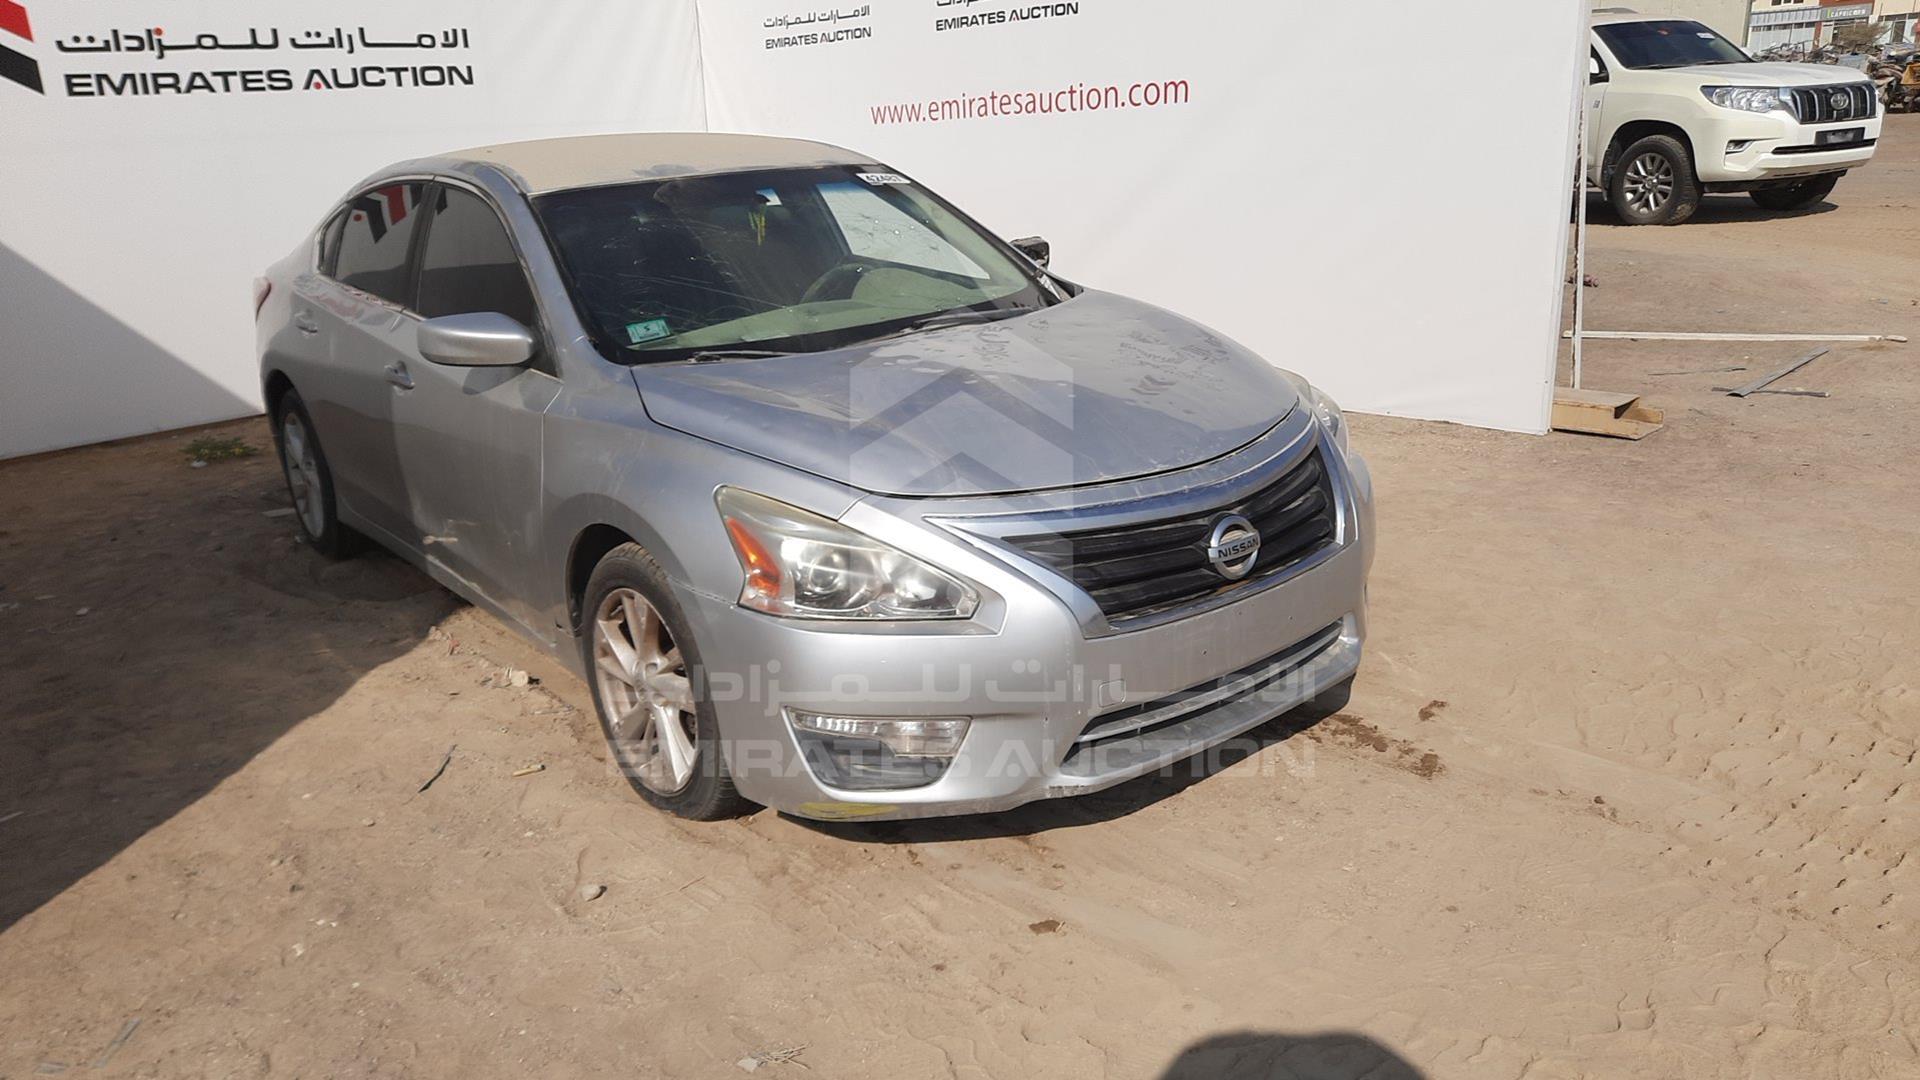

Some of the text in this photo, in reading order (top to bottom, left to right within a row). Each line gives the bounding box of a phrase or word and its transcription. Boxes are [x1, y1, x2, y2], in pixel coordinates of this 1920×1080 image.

[818, 5, 870, 24] الامارات
[936, 2, 1079, 31] EMIRATES AUCTION
[55, 27, 469, 59] الامارات للمزادات
[765, 27, 872, 49] EMIRATES AUCTION
[64, 65, 474, 96] EMIRATES AUCTION
[870, 79, 1189, 125] www.emiratesauction.com
[1218, 537, 1258, 558] NISSAN
